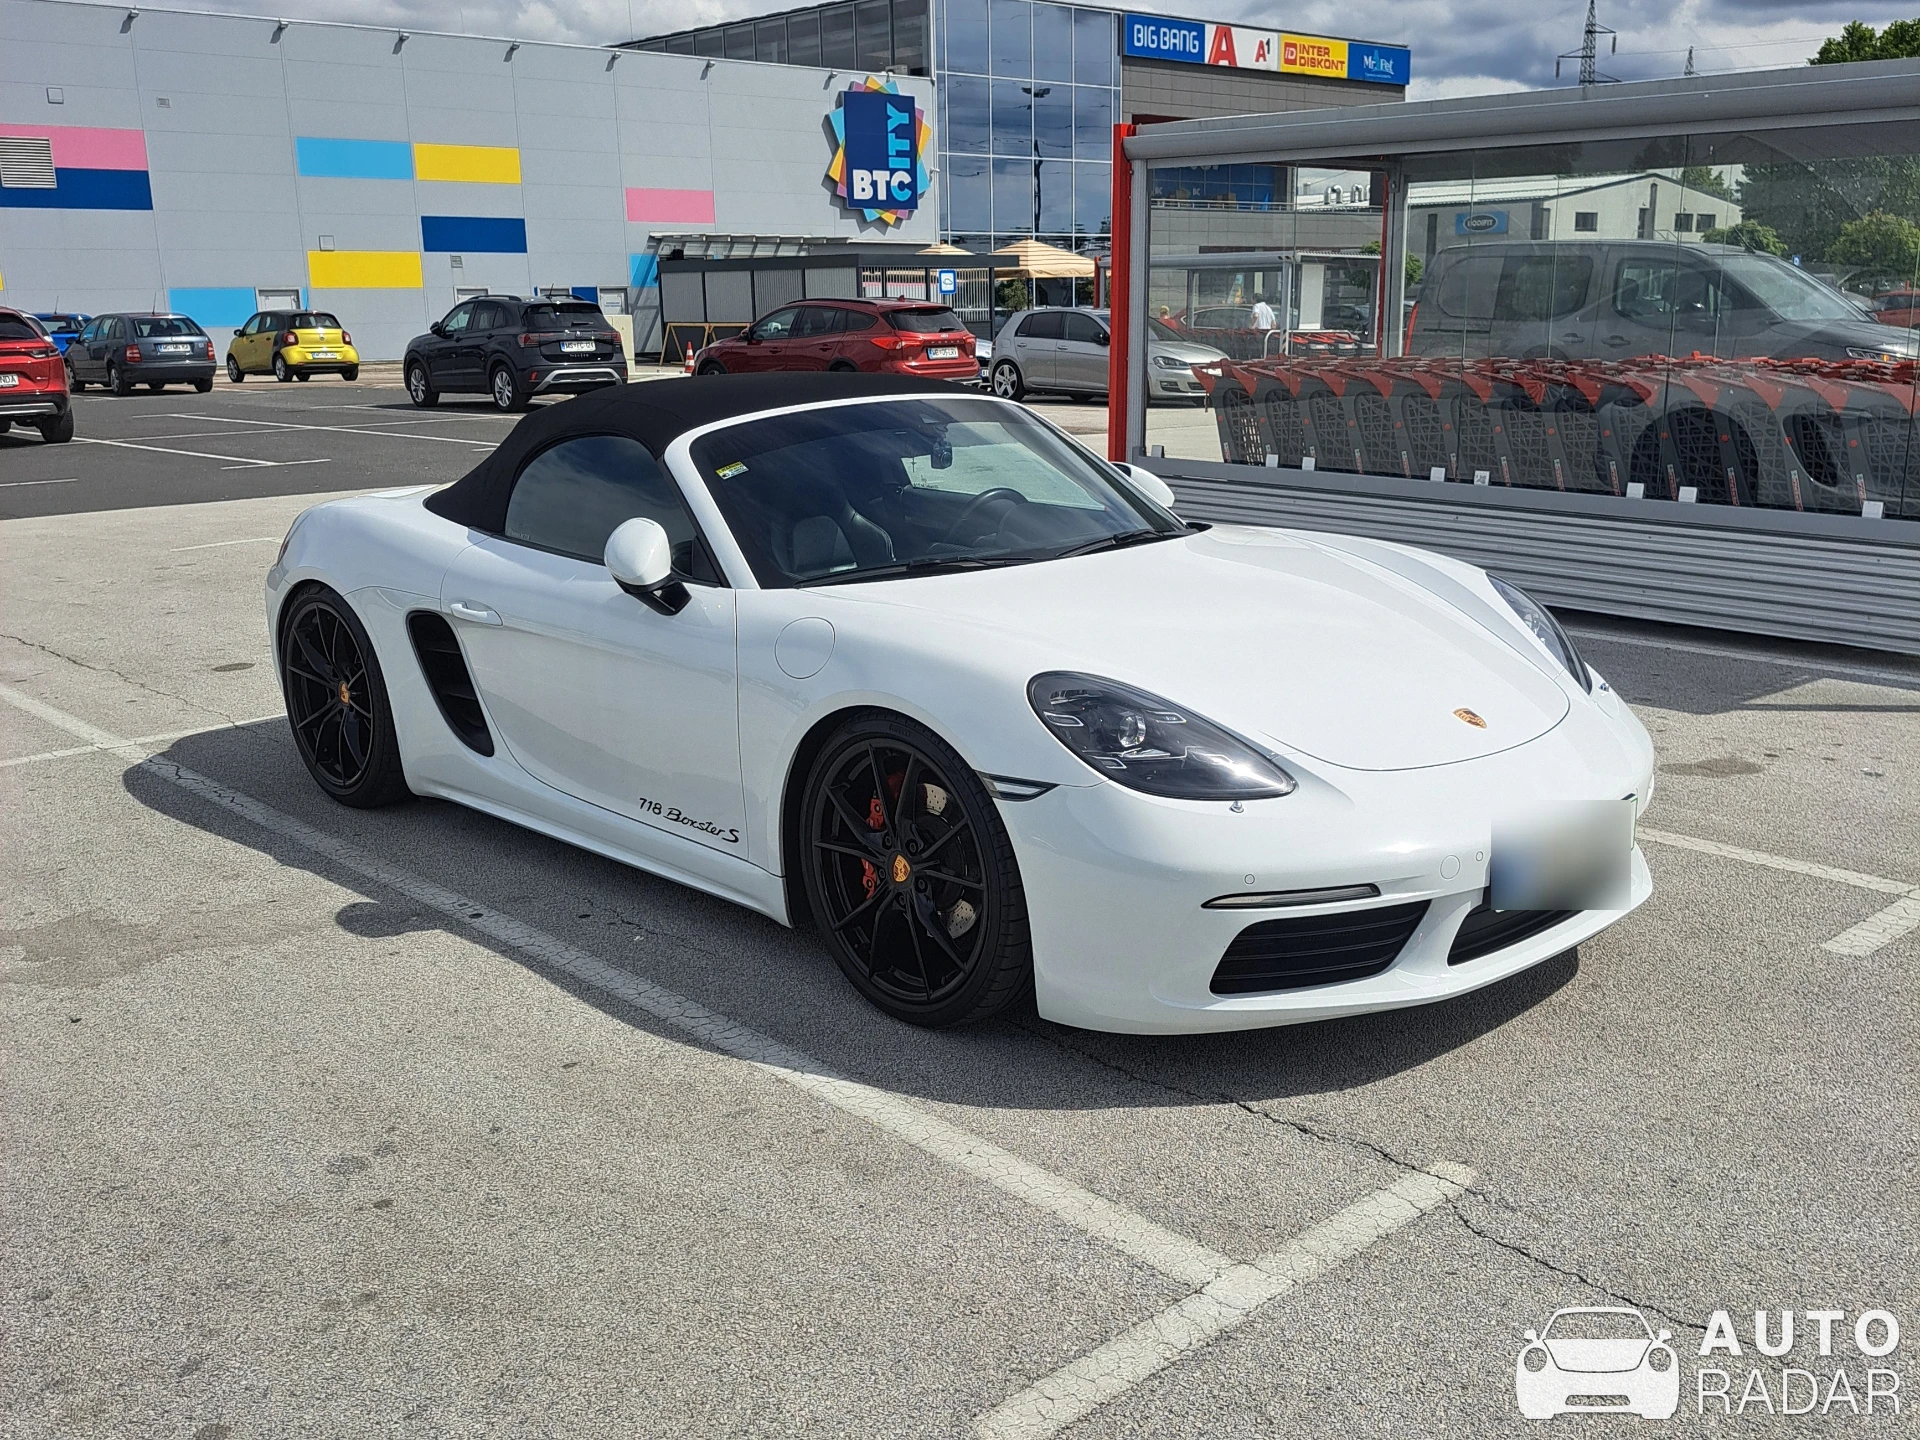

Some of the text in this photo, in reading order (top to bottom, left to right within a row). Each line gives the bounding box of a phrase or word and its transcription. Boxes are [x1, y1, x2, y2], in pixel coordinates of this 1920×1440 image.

[1133, 24, 1199, 54] BIG BANG
[1207, 25, 1238, 68] A
[1254, 38, 1271, 63] A1
[1298, 43, 1331, 57] INTER
[1298, 55, 1345, 71] DISKONT
[853, 169, 912, 201] BTC
[639, 797, 740, 844] 718 Boxster S
